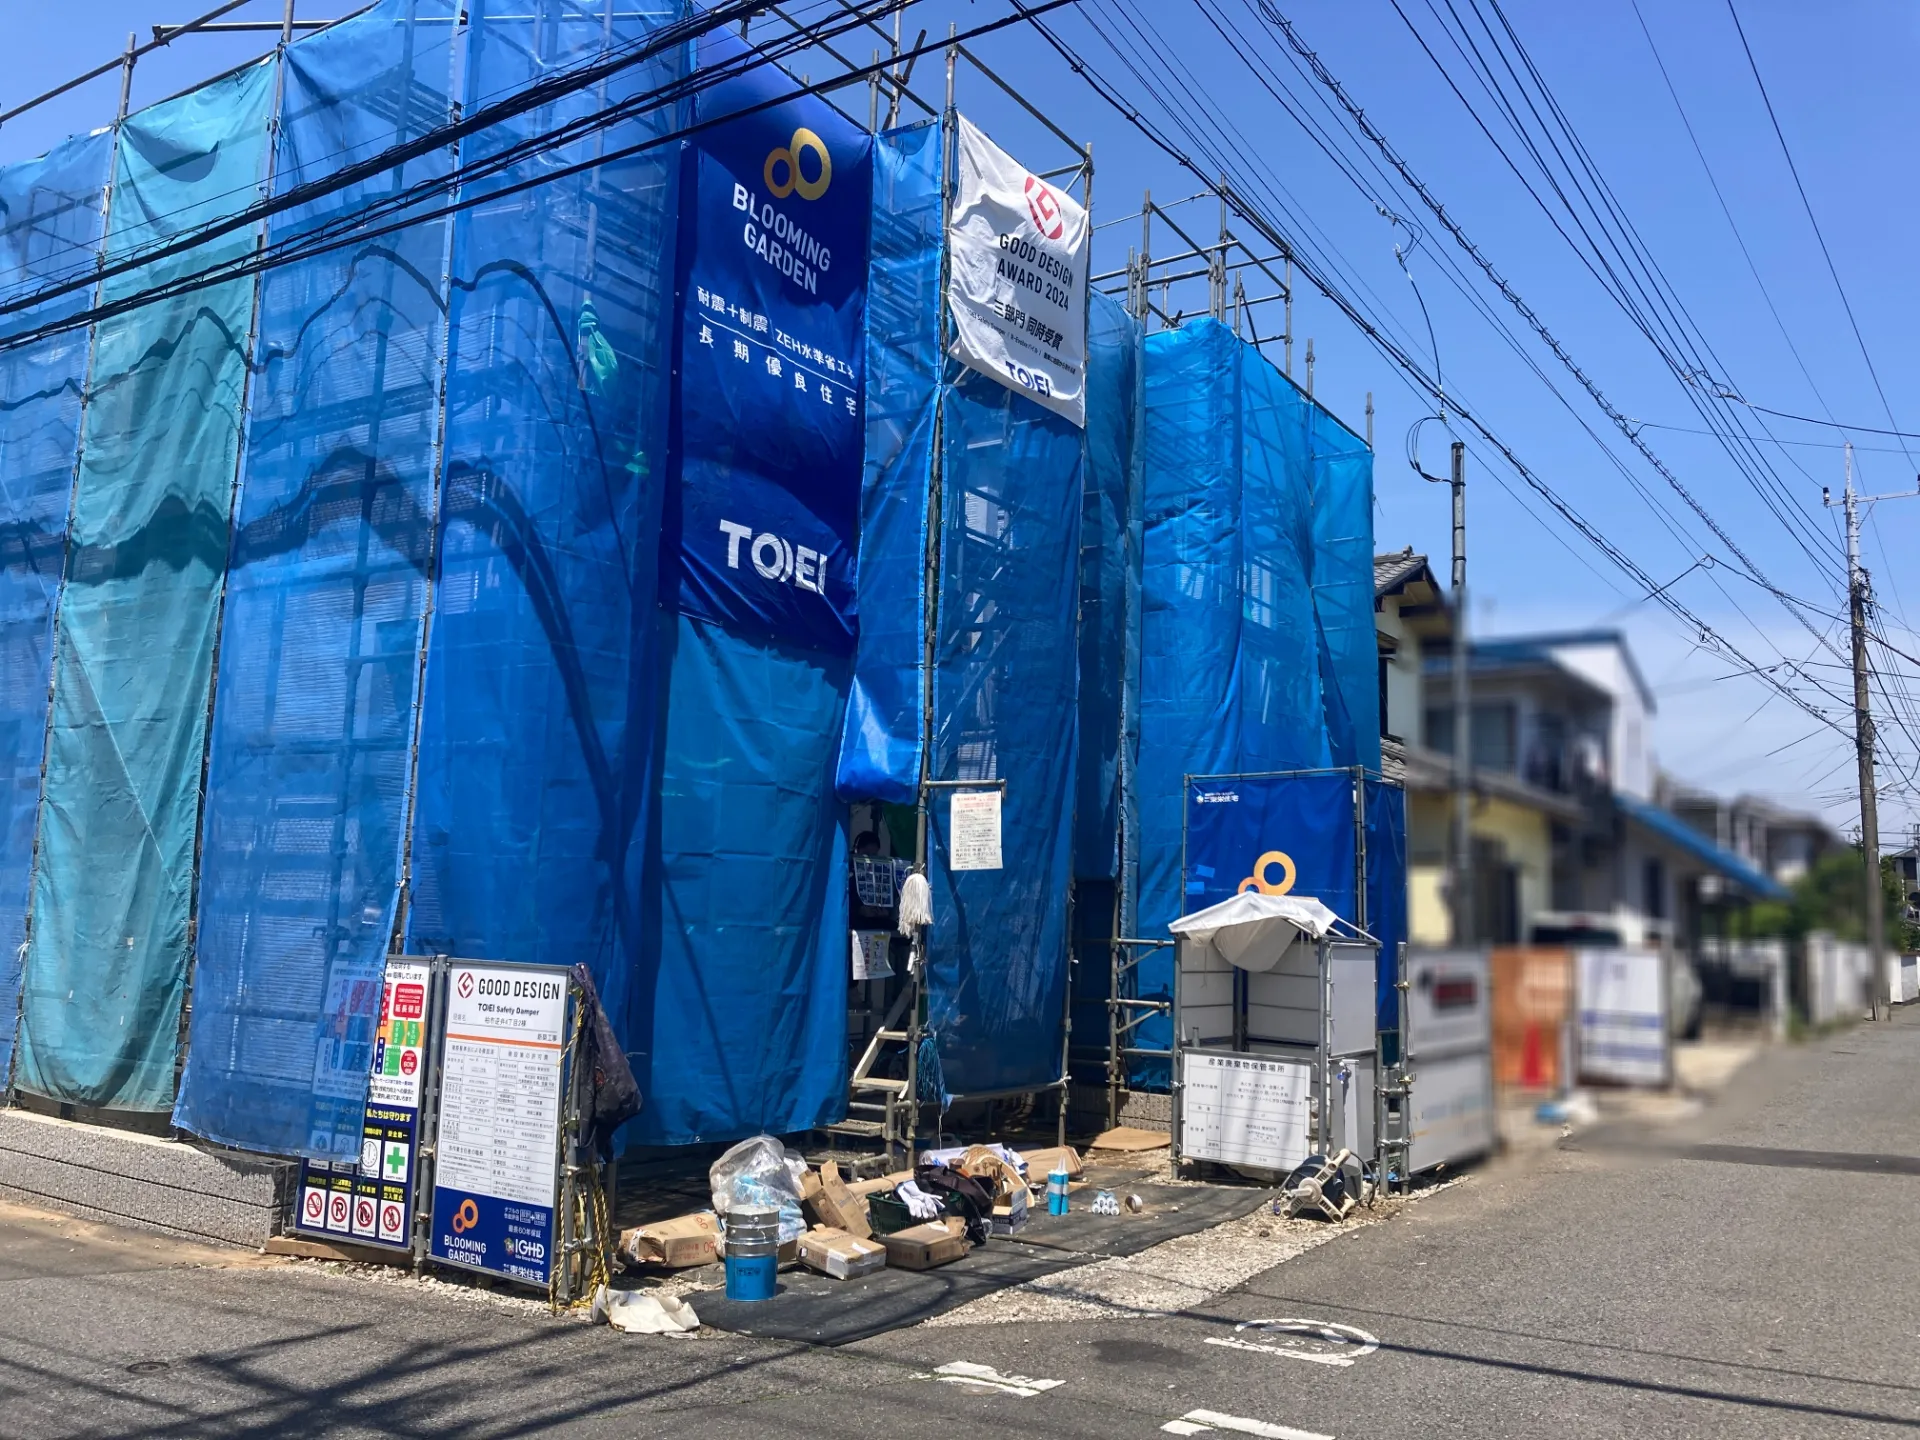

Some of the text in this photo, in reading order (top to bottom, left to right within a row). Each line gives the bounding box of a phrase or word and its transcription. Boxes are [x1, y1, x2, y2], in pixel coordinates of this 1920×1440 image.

[733, 182, 831, 272] BLOOMING
[744, 222, 817, 295] GARDEN
[1000, 233, 1074, 289] GOOD DESIGN
[997, 258, 1069, 312] AWARD 2024
[994, 299, 1063, 351] 三部門 同時受賞
[478, 978, 560, 1000] GOOD DESIGN
[496, 1005, 514, 1015] Safety
[516, 1007, 539, 1016] Damper
[1208, 1058, 1285, 1073] 産業廃棄物保管場所
[444, 1234, 487, 1254] BLOOMING
[515, 1238, 545, 1259] IGHD
[448, 1249, 482, 1266] GARDEN
[510, 1263, 543, 1282] 東栄住宅
